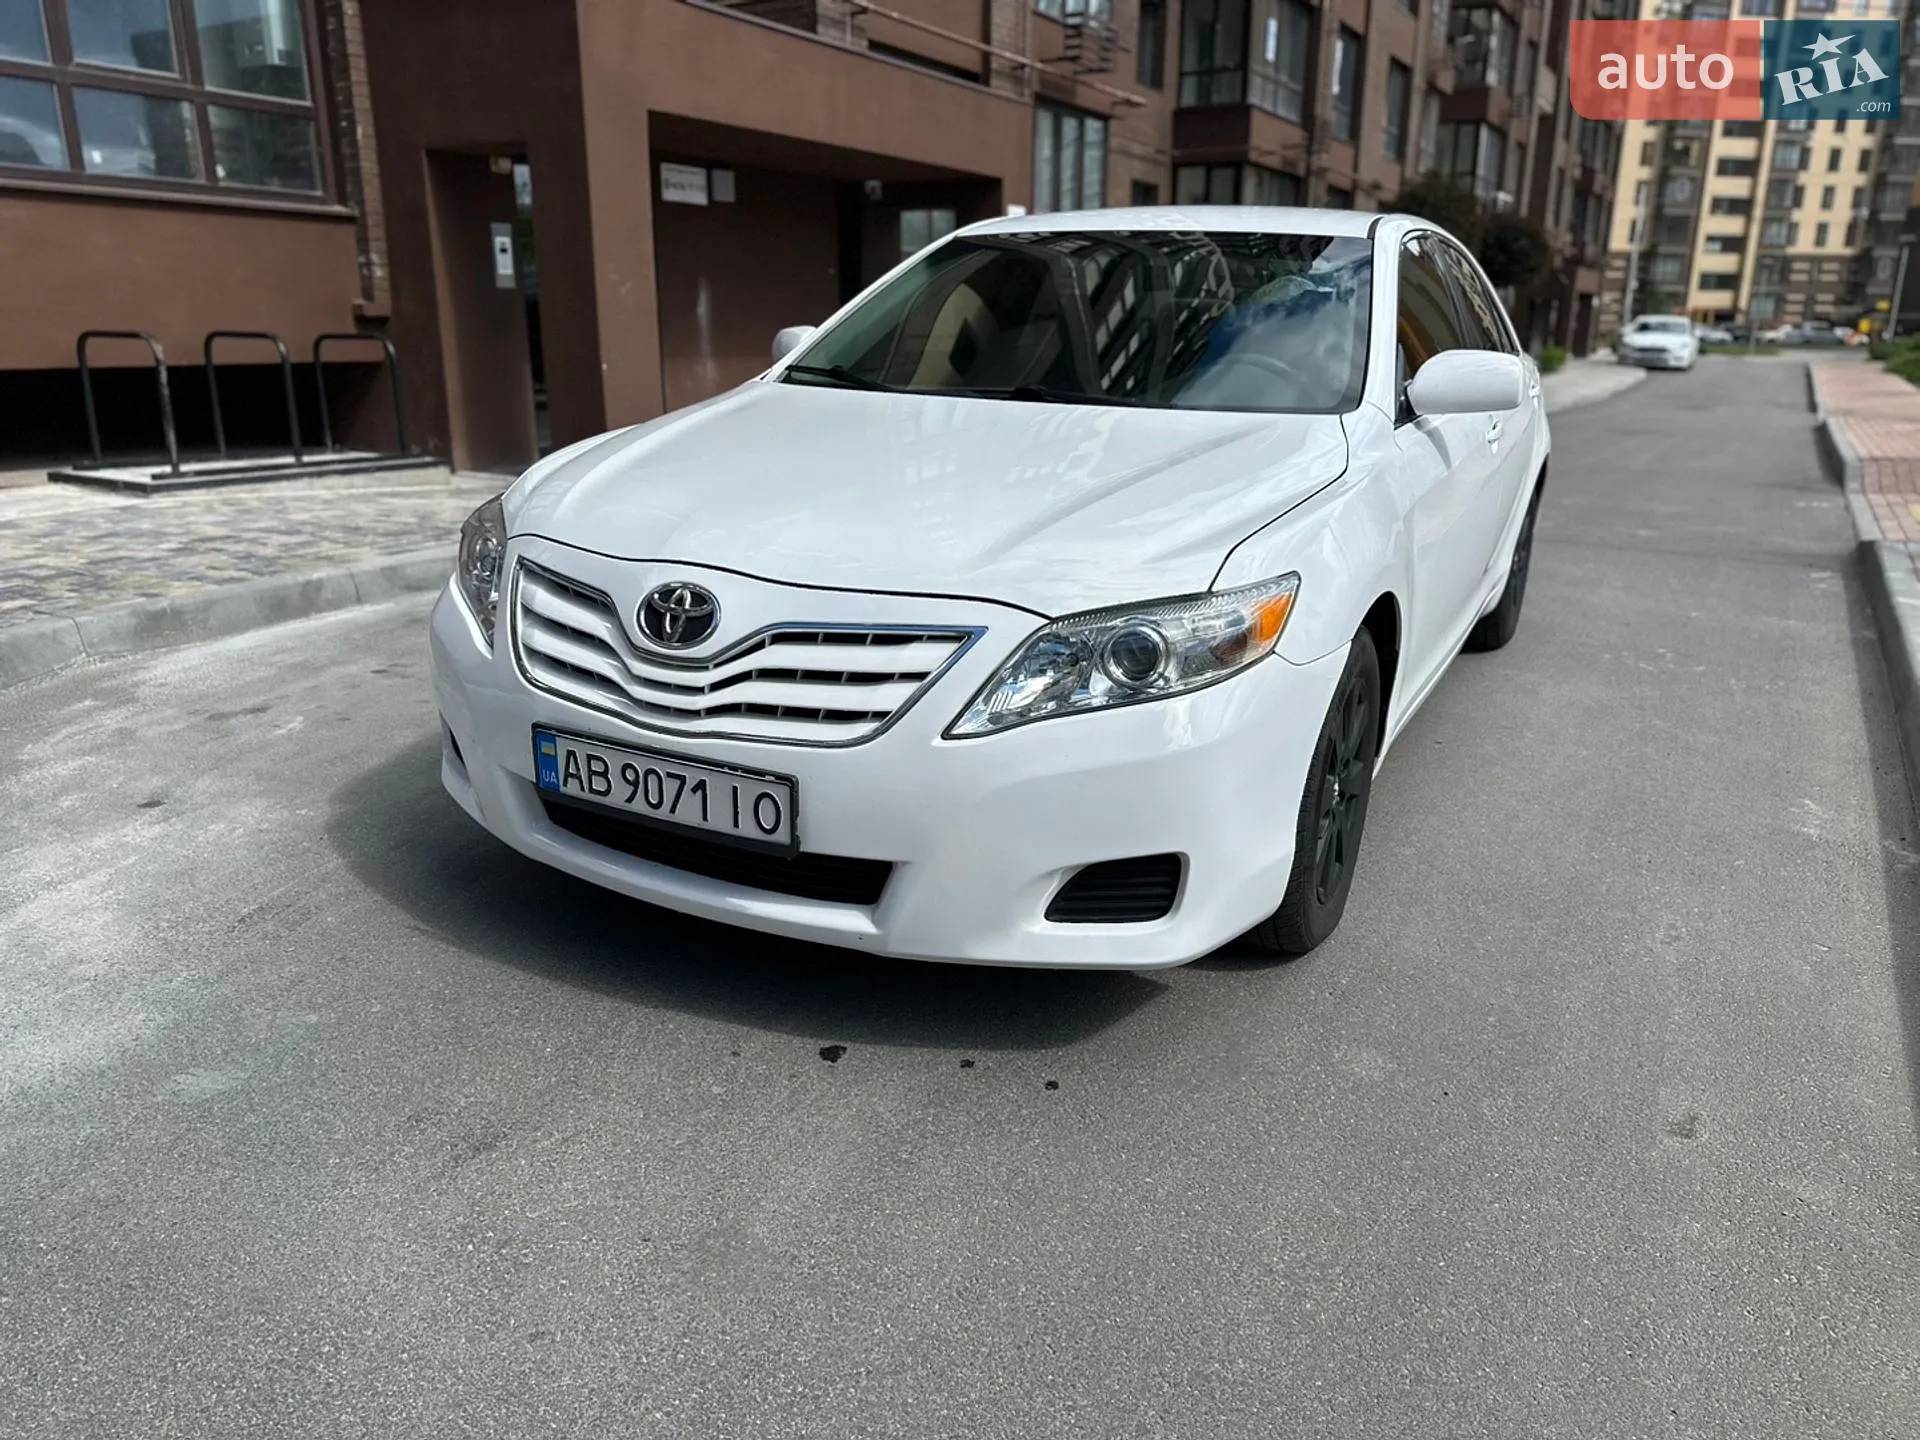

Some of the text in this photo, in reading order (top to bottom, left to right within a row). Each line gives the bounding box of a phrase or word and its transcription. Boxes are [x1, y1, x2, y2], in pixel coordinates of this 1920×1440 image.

[543, 769, 558, 784] UA
[563, 748, 782, 835] AB 9071 IO
